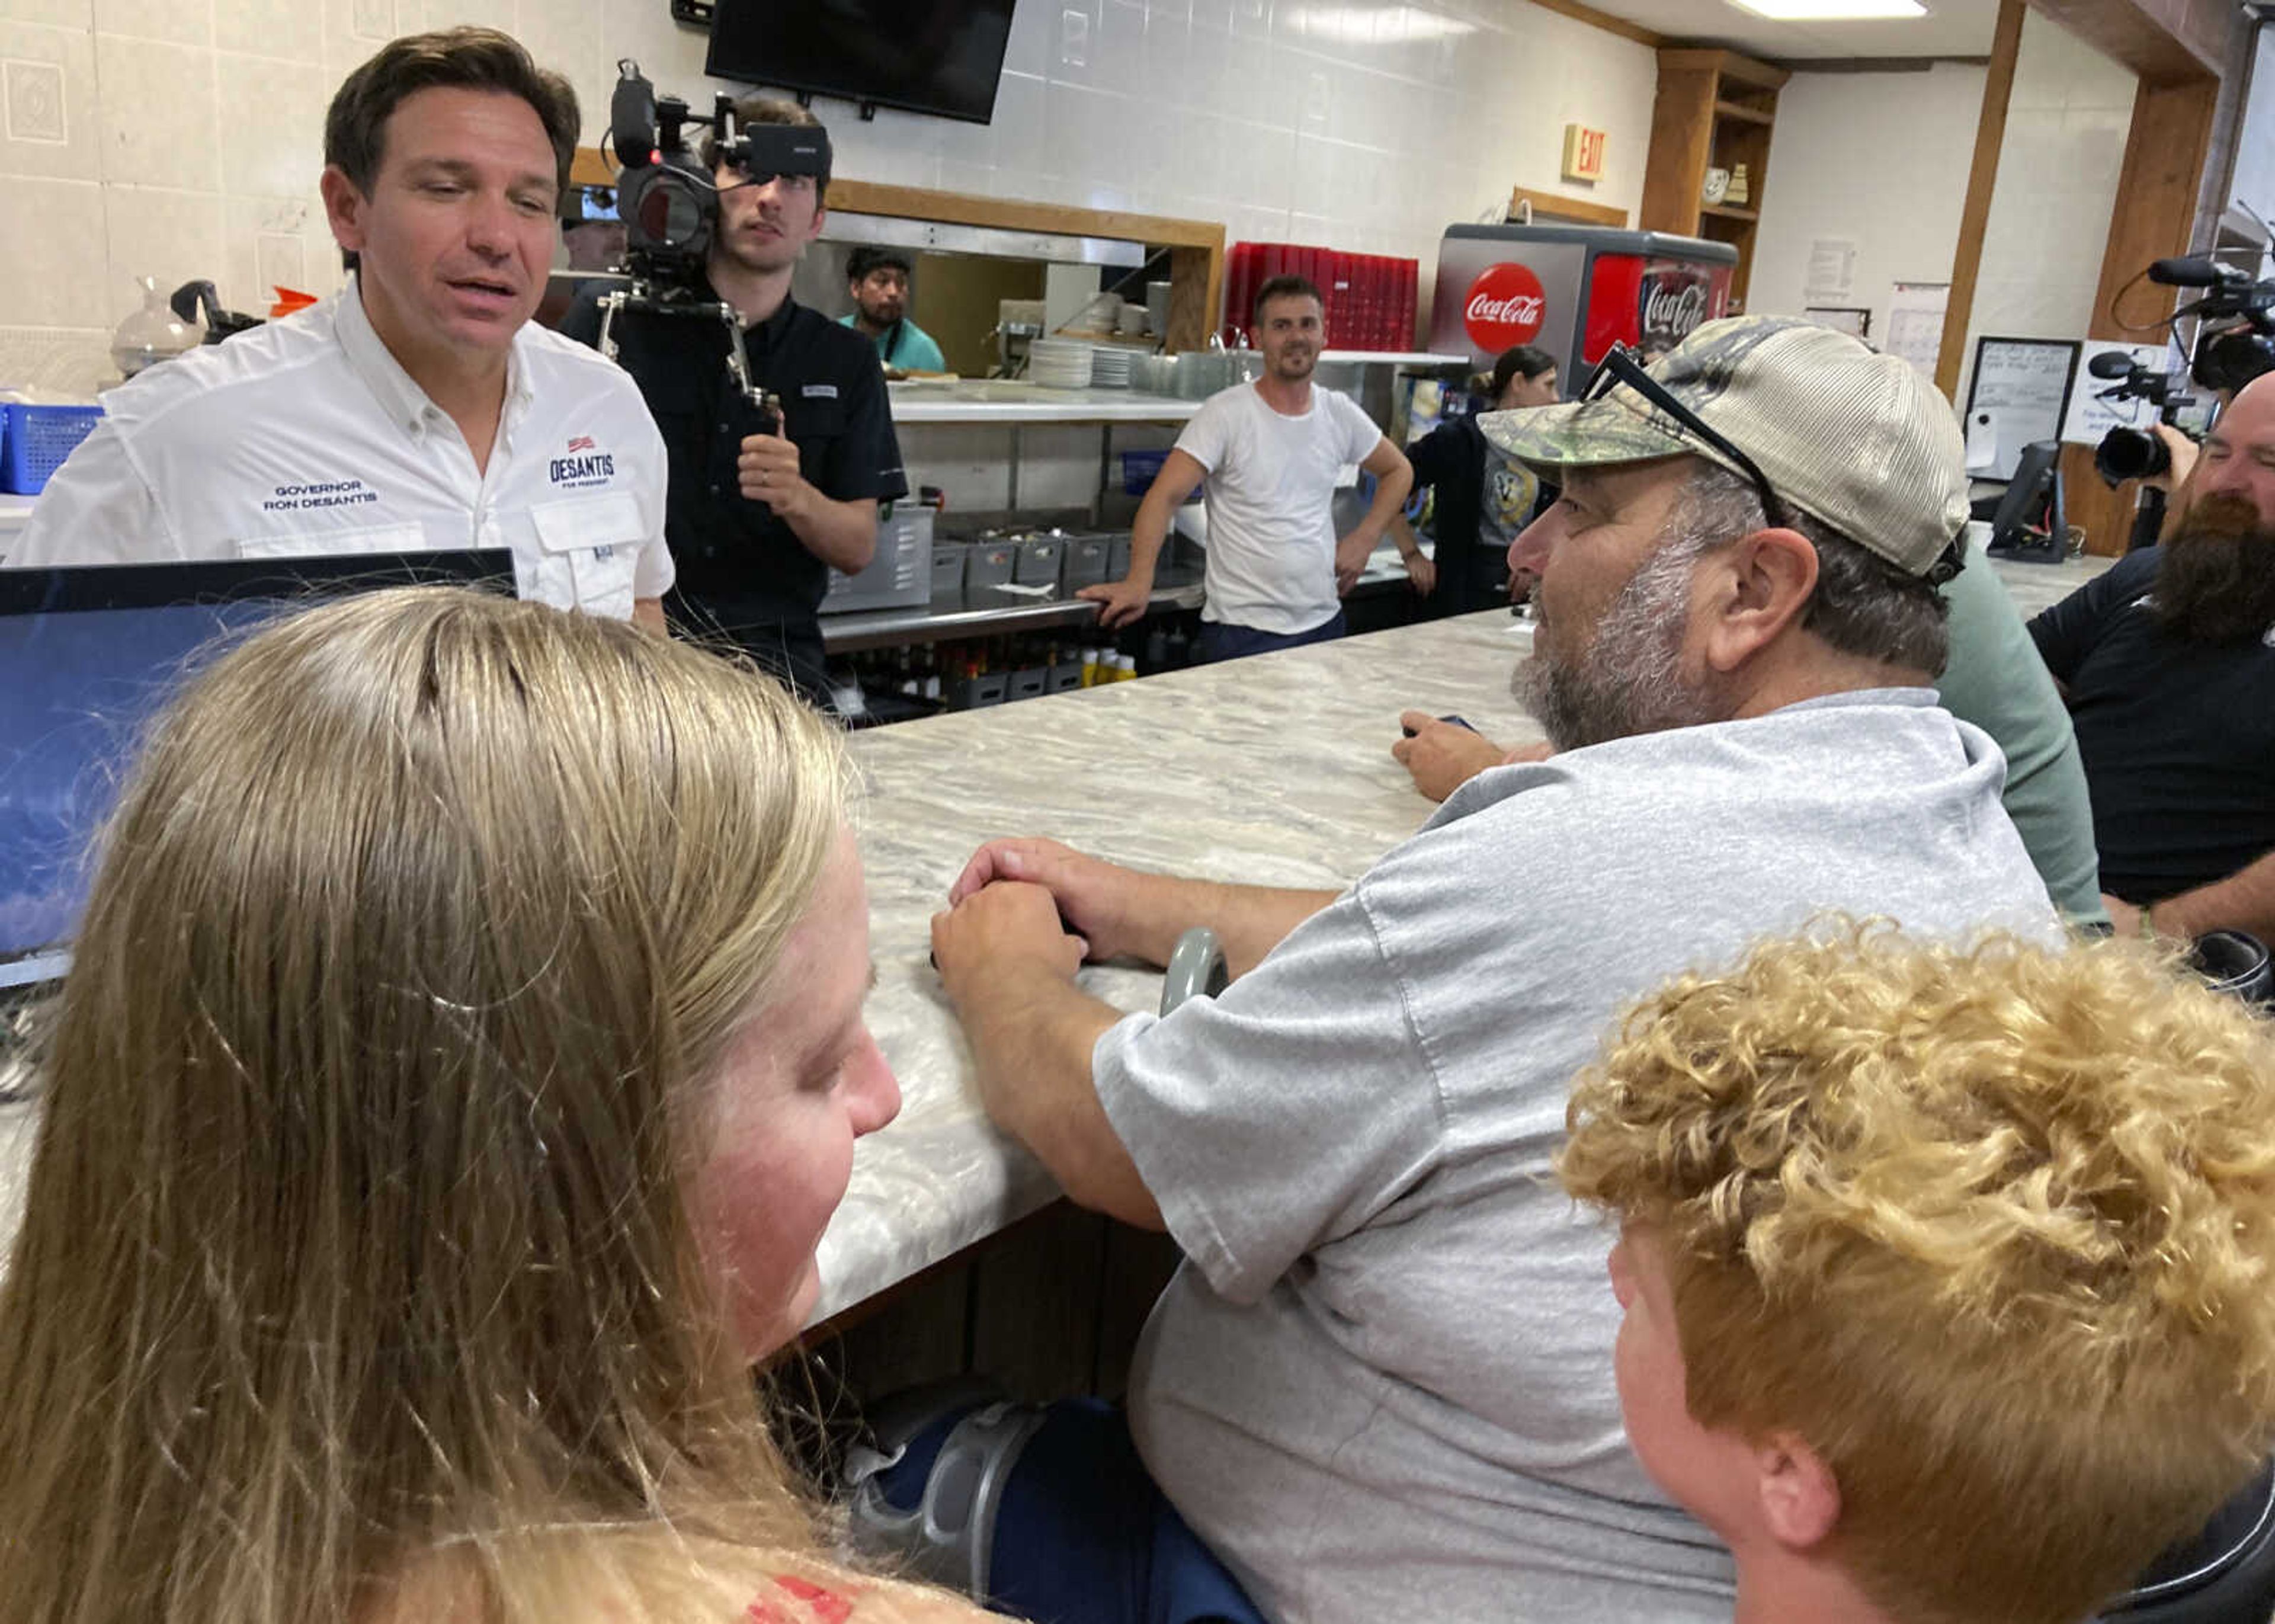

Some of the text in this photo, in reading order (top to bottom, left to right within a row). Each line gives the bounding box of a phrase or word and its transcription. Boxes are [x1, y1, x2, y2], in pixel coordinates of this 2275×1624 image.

[1578, 129, 1605, 174] EXIT
[550, 454, 614, 483] DESANTIS
[275, 481, 361, 496] GOVERNOR
[264, 492, 377, 510] RON DESANTIS
